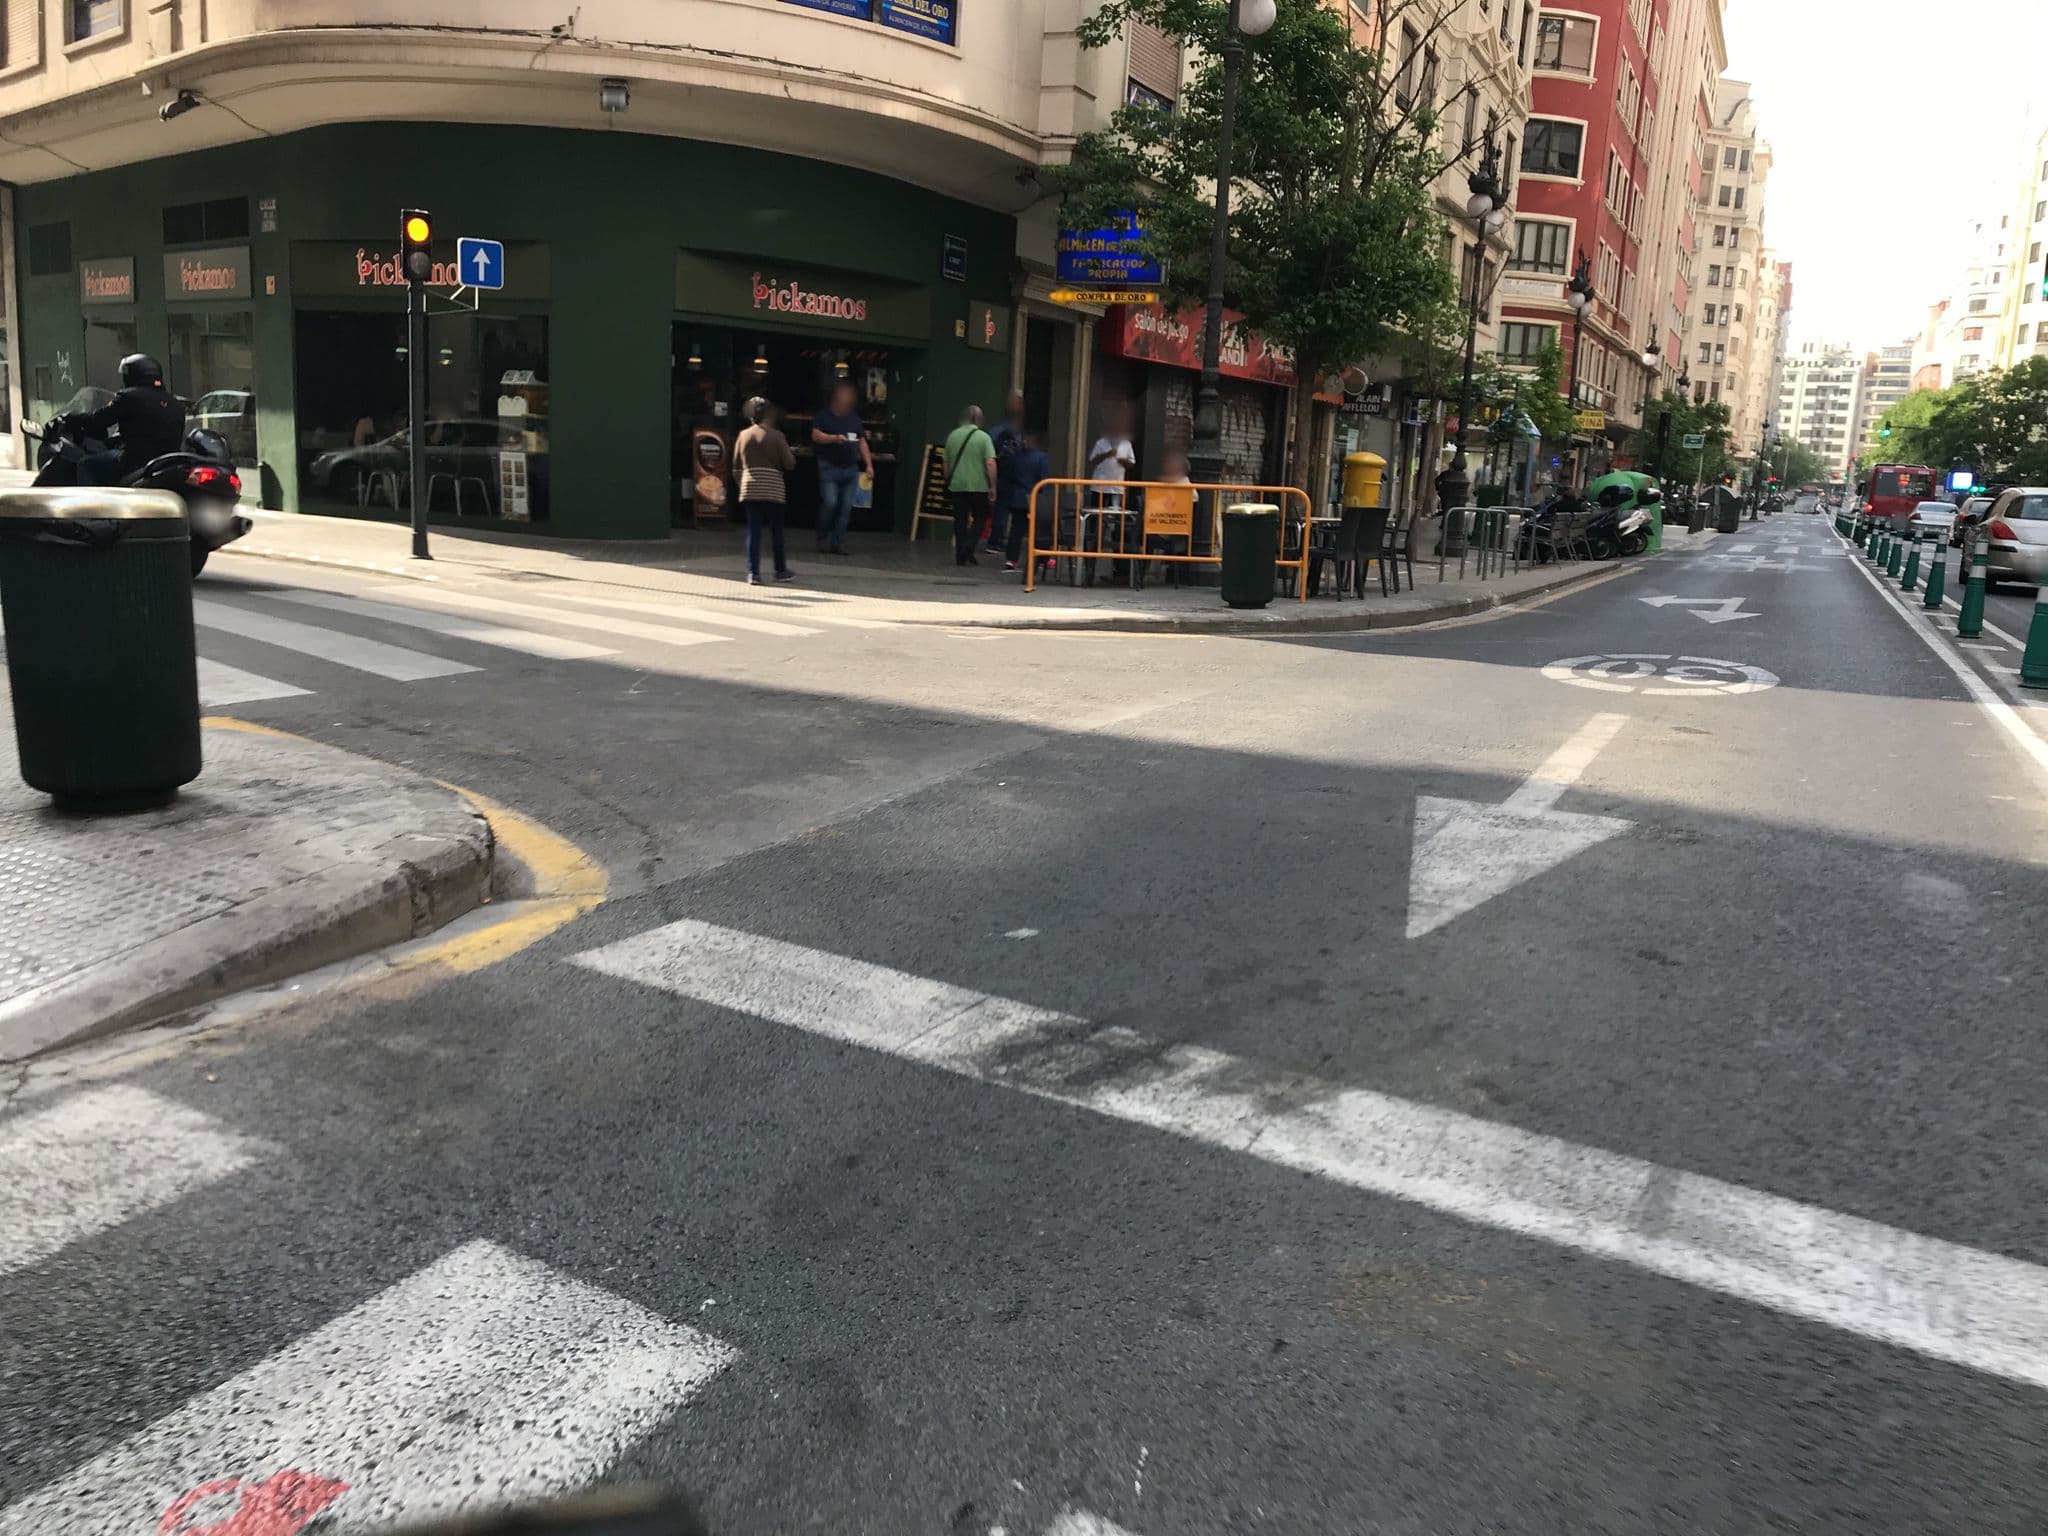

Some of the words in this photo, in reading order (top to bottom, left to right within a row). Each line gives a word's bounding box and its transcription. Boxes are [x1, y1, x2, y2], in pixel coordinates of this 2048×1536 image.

[932, 4, 949, 19] ORO
[1076, 292, 1112, 302] COMPRA
[1114, 292, 1127, 302] DE
[1127, 293, 1147, 302] ORO
[1355, 394, 1381, 403] ALAIN
